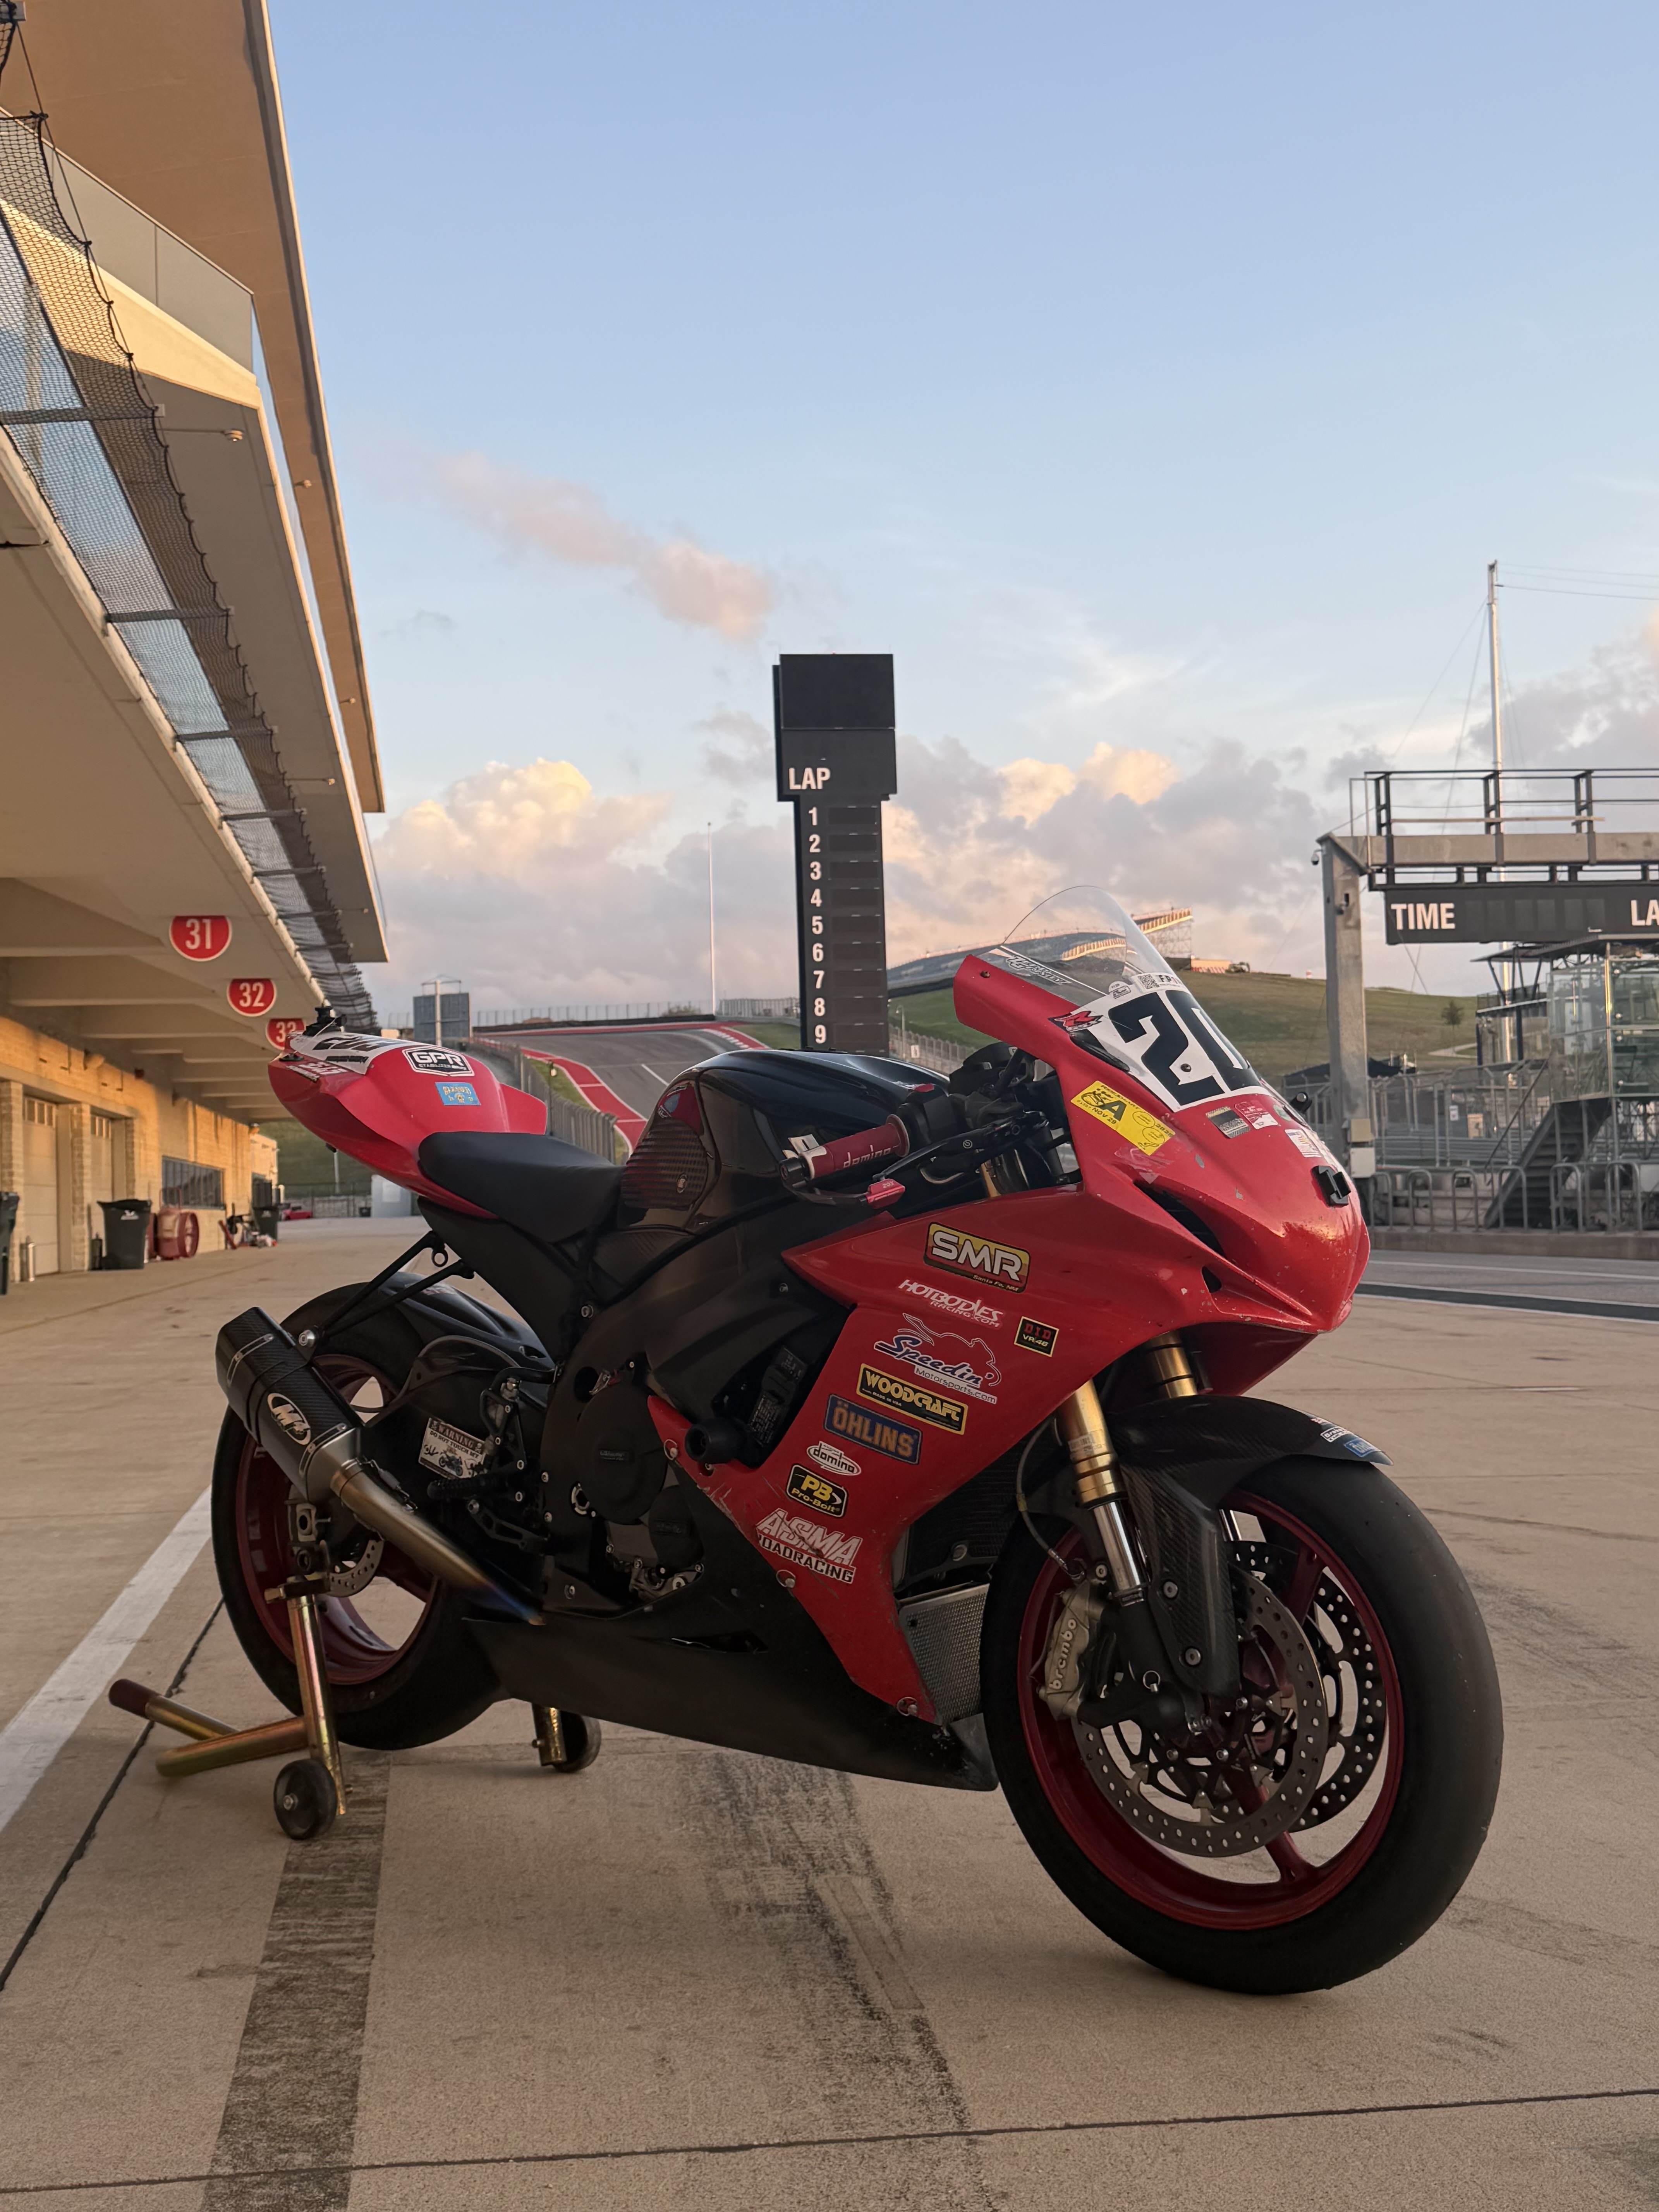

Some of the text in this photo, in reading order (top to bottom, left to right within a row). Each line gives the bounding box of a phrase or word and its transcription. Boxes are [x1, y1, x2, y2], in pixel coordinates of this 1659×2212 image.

[789, 768, 830, 790] LAP
[809, 807, 817, 826] 1
[809, 834, 821, 853] 2
[810, 861, 822, 880] 3
[810, 888, 822, 907] 4
[812, 916, 823, 934] 5
[1390, 903, 1455, 930] TIME
[185, 918, 212, 950] 31
[812, 943, 824, 962] 6
[813, 970, 825, 989] 7
[239, 982, 265, 1007] 32
[814, 998, 825, 1017] 8
[815, 1025, 826, 1044] 9
[412, 1051, 464, 1066] GPR
[1092, 1107, 1107, 1118] NOV
[843, 1144, 891, 1169] domino
[931, 1230, 1022, 1281] SMR
[973, 1274, 993, 1285] Santa
[898, 1279, 1004, 1322] HOTBODIES
[866, 1370, 961, 1422] WOODCRAFT
[915, 1367, 996, 1404] Motorsports.com
[438, 1422, 474, 1450] WARNING
[832, 1400, 914, 1458] ÖHLINS
[438, 1434, 450, 1444] NOT
[450, 1440, 469, 1454] TOUCH
[813, 1443, 855, 1473] domino
[801, 1474, 833, 1501] PB
[1048, 1618, 1077, 1690] brembo
